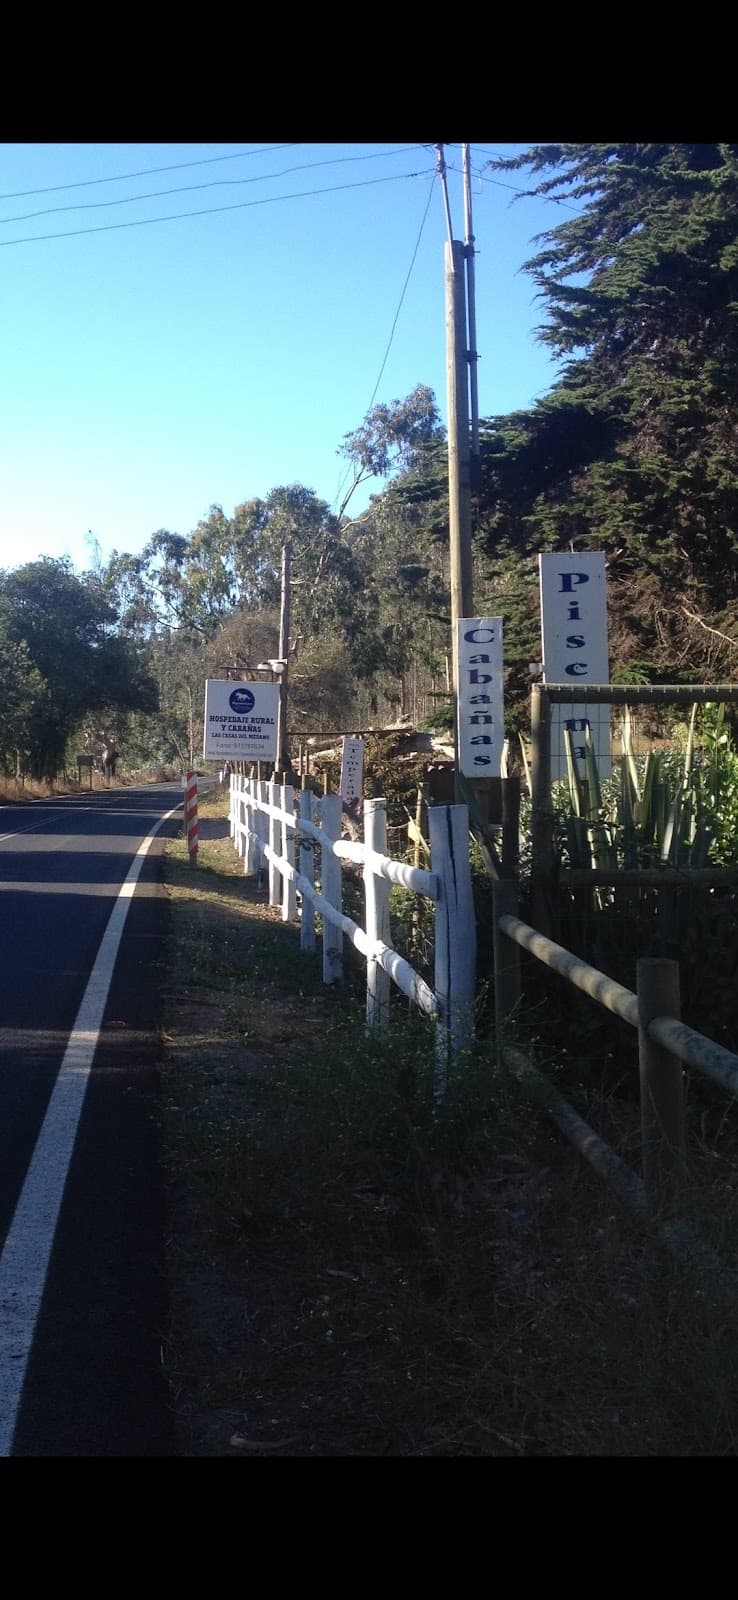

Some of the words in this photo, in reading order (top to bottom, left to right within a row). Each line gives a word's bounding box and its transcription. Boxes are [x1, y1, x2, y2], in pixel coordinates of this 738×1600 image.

[463, 628, 496, 767] Cabañas
[557, 572, 593, 760] Piscna
[209, 715, 249, 724] HOSPEDAJE
[249, 717, 275, 725] RURAL
[221, 724, 227, 732] Y
[228, 724, 262, 733] CABAÑAS
